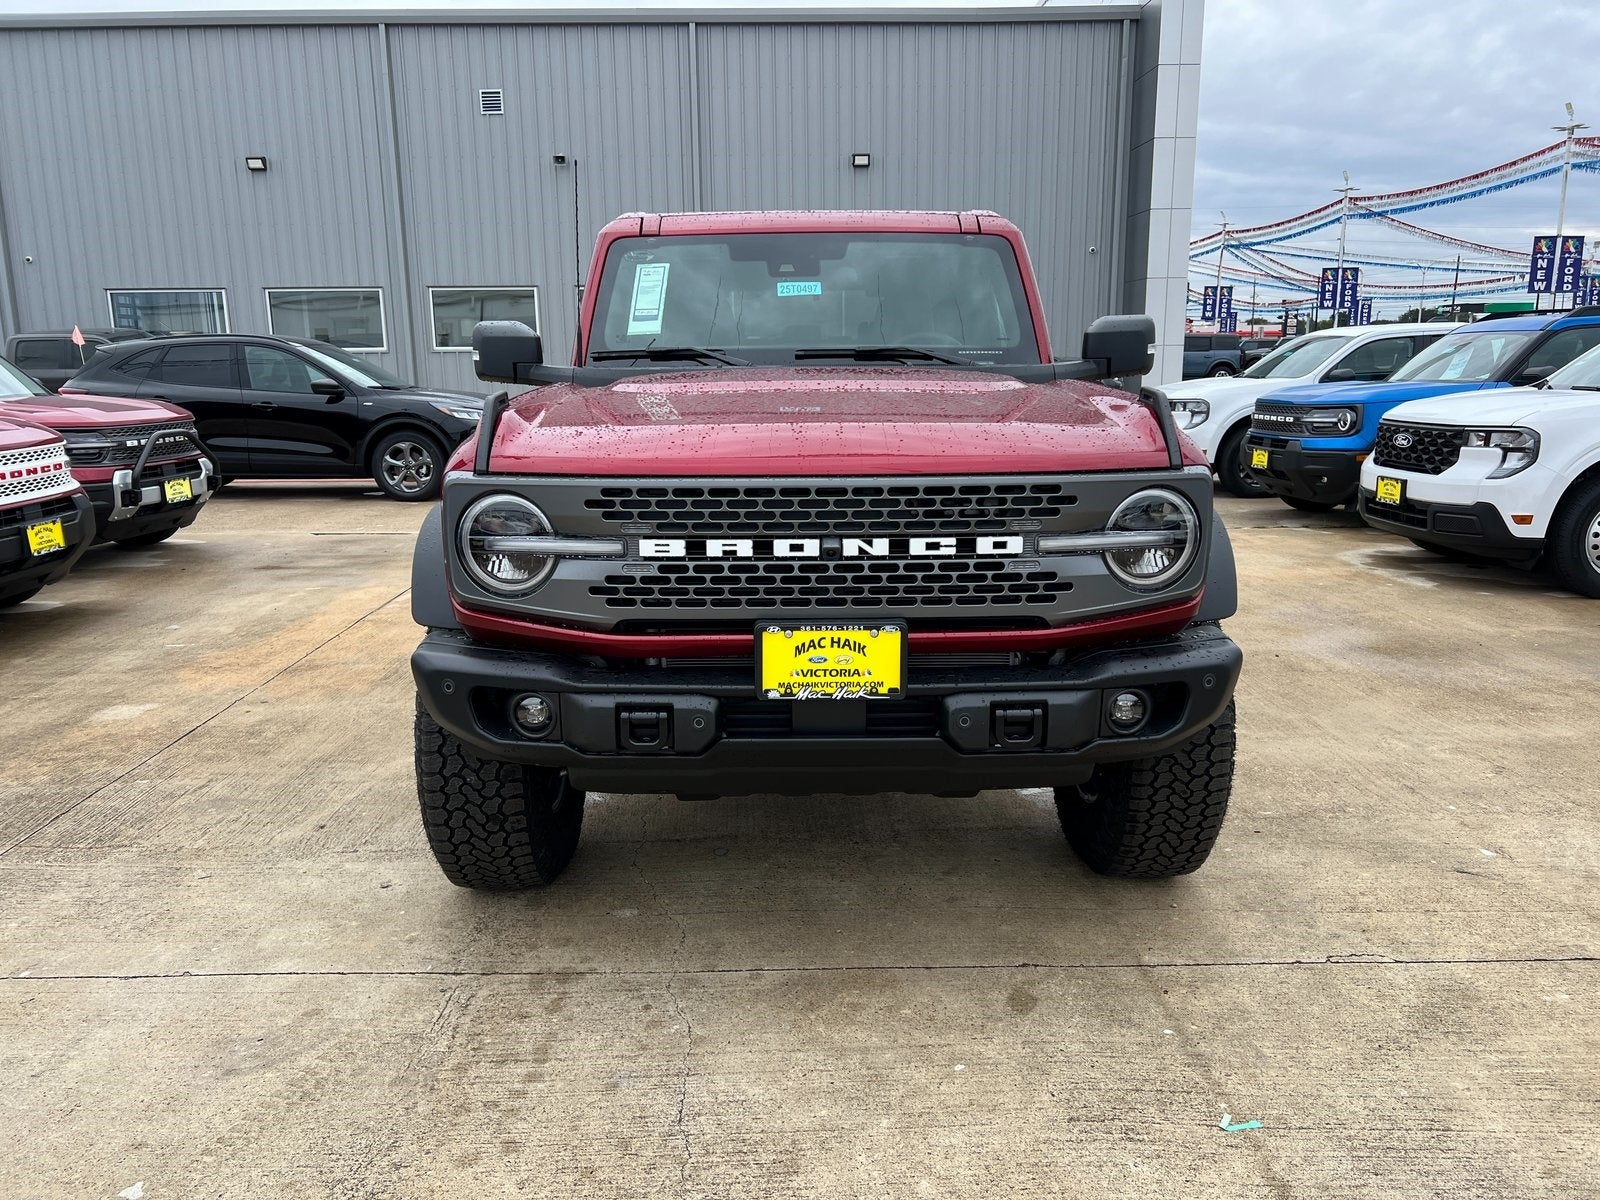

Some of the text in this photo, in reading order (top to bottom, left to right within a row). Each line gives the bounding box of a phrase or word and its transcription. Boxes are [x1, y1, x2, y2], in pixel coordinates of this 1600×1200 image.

[1533, 259, 1547, 290] NEW
[1563, 259, 1574, 291] FORD
[780, 284, 817, 294] 25T0497
[1323, 284, 1333, 307] NEW
[1205, 299, 1213, 317] NEW
[1253, 413, 1294, 422] BRONCO
[0, 463, 63, 480] ONCO
[639, 536, 1023, 557] BRONCO
[794, 637, 867, 658] MAC HAIK
[800, 668, 861, 677] VICTORIA
[796, 686, 869, 700] Mac Haik
